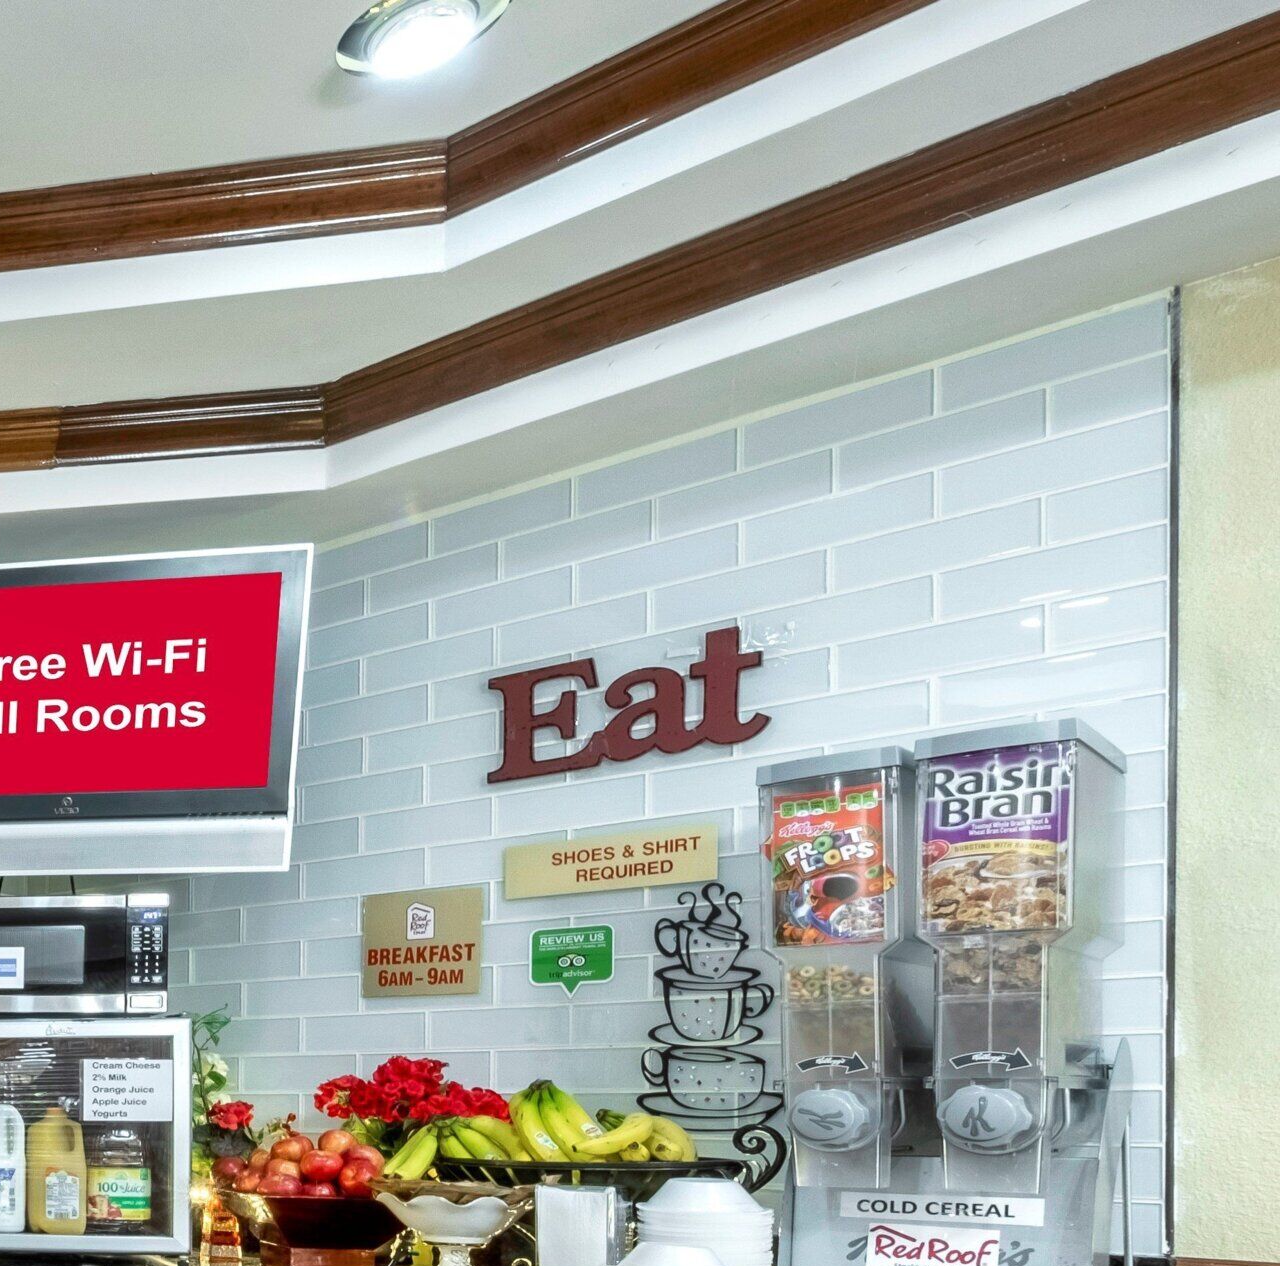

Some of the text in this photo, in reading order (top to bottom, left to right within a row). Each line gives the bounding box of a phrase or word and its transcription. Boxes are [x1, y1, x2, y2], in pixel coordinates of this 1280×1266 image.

[82, 638, 207, 677] Wi-Fi
[36, 699, 206, 733] Rooms
[487, 626, 772, 784] Eat
[941, 791, 1053, 828] Bran
[551, 836, 702, 866] SHOES & SHIRT
[800, 841, 875, 874] LOOPS
[576, 859, 674, 882] REQUIRED
[539, 932, 605, 946] REVIEW US
[367, 943, 476, 966] BREAKFAST
[378, 969, 413, 987] 6AM
[427, 967, 464, 985] 9AM
[92, 1061, 161, 1069] Cream Cheese
[92, 1073, 127, 1081] 2% Milk
[92, 1085, 154, 1094] Orange Juice
[92, 1098, 120, 1106] Apple
[92, 1110, 128, 1118] Yogurts
[856, 1199, 1016, 1218] COLD CEREAL
[874, 1234, 925, 1259] Red
